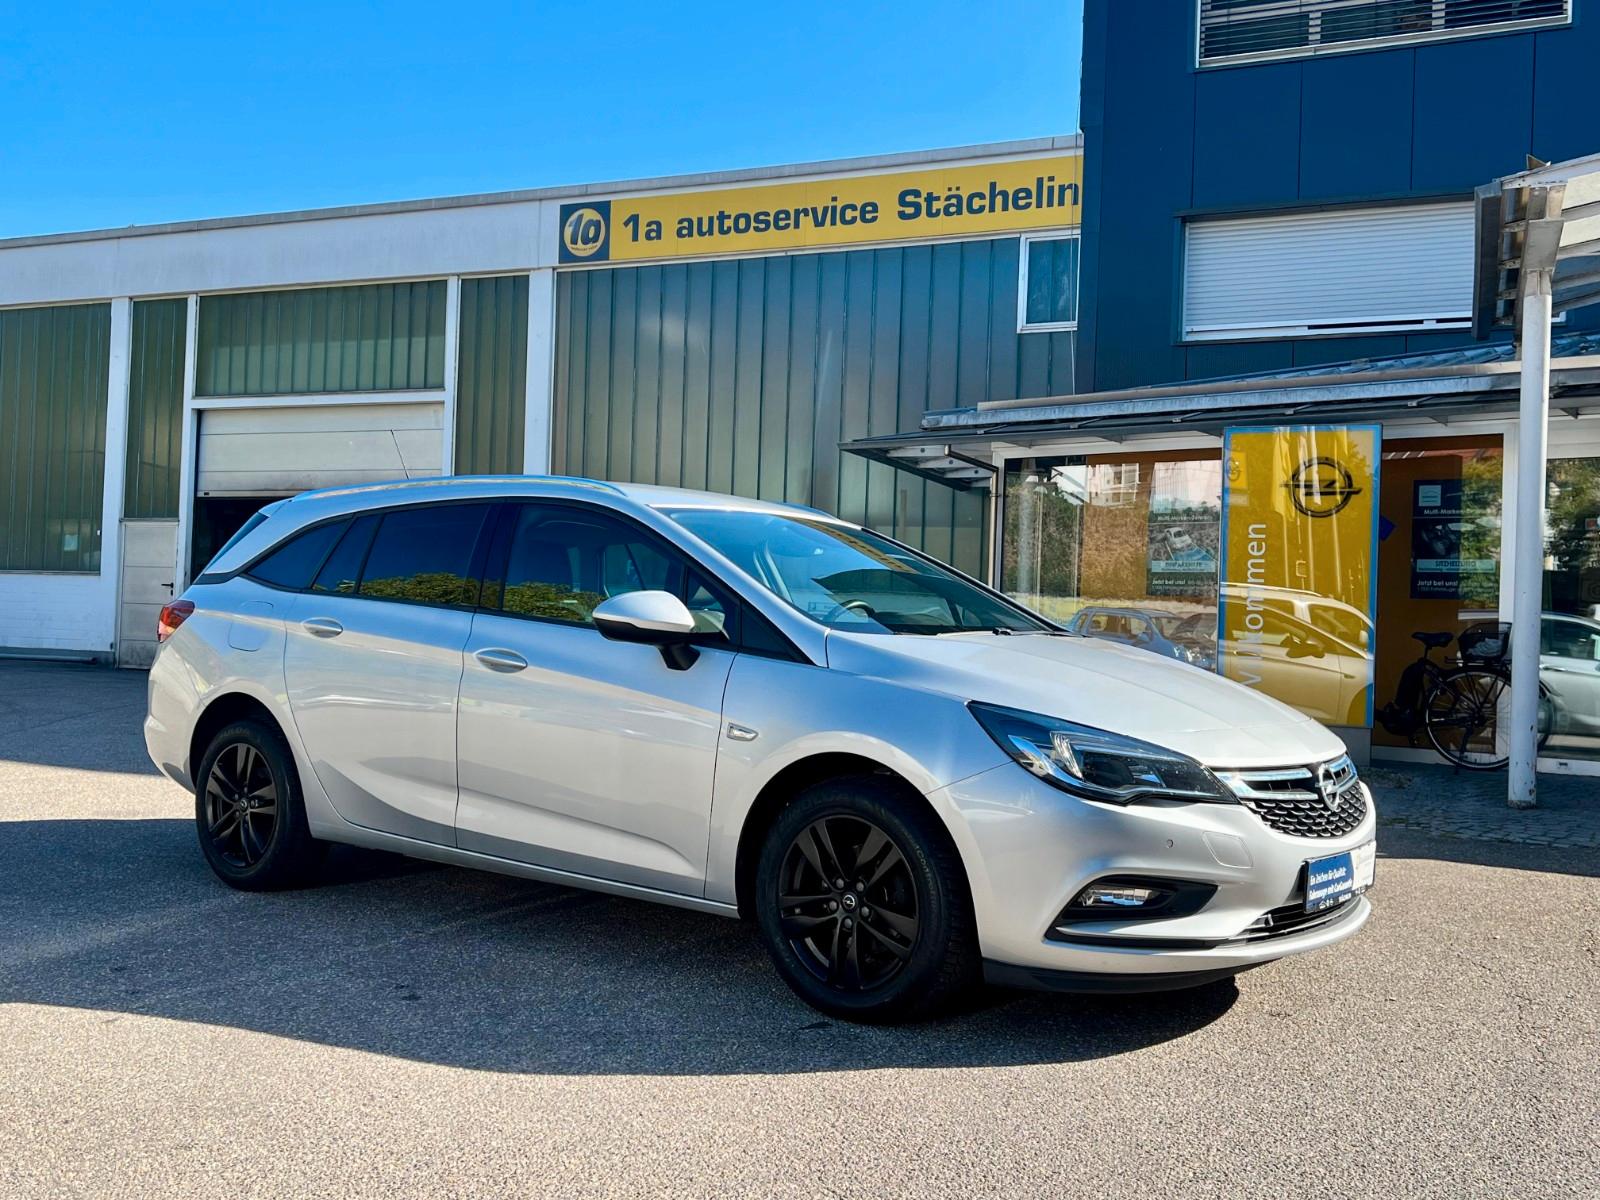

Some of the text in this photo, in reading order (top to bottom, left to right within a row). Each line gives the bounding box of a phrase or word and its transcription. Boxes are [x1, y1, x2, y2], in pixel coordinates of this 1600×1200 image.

[568, 213, 602, 246] 1a
[623, 175, 1080, 243] 1a autoservice Stächelin
